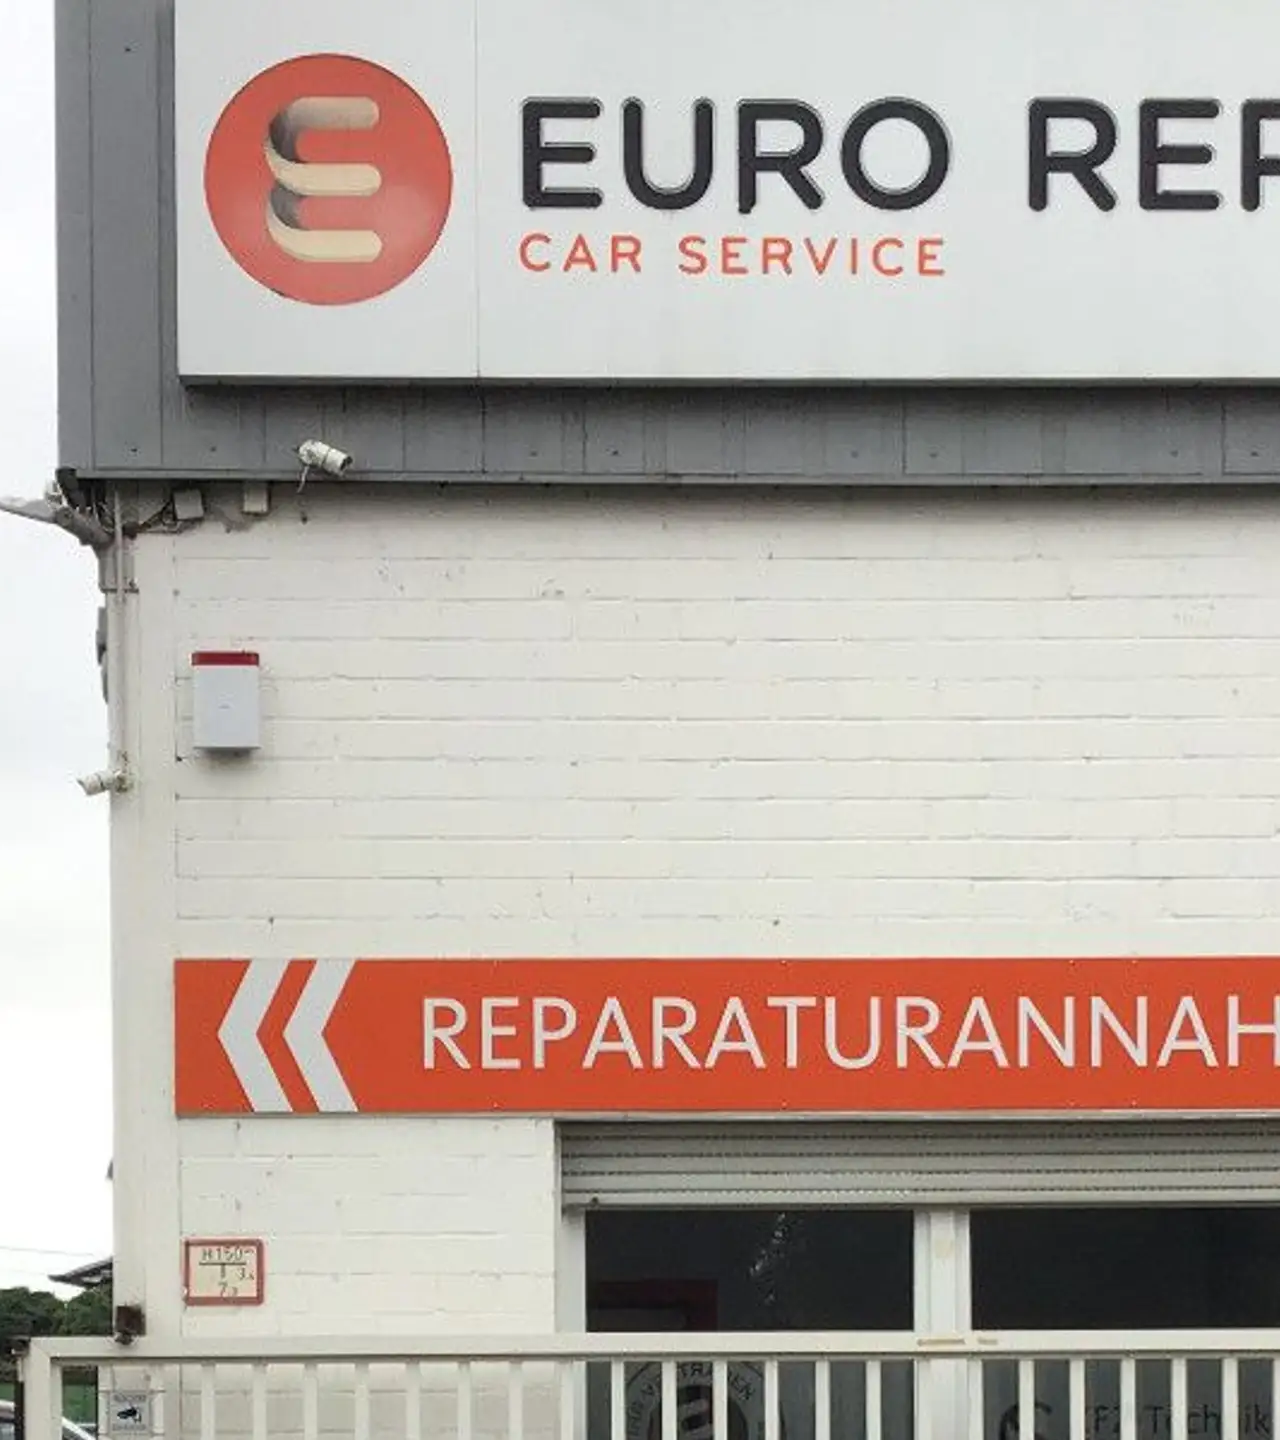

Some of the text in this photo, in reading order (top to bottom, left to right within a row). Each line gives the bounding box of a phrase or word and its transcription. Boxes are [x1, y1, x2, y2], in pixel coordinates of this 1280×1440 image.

[521, 96, 952, 213] EURO
[519, 233, 947, 277] CAR SERVICE
